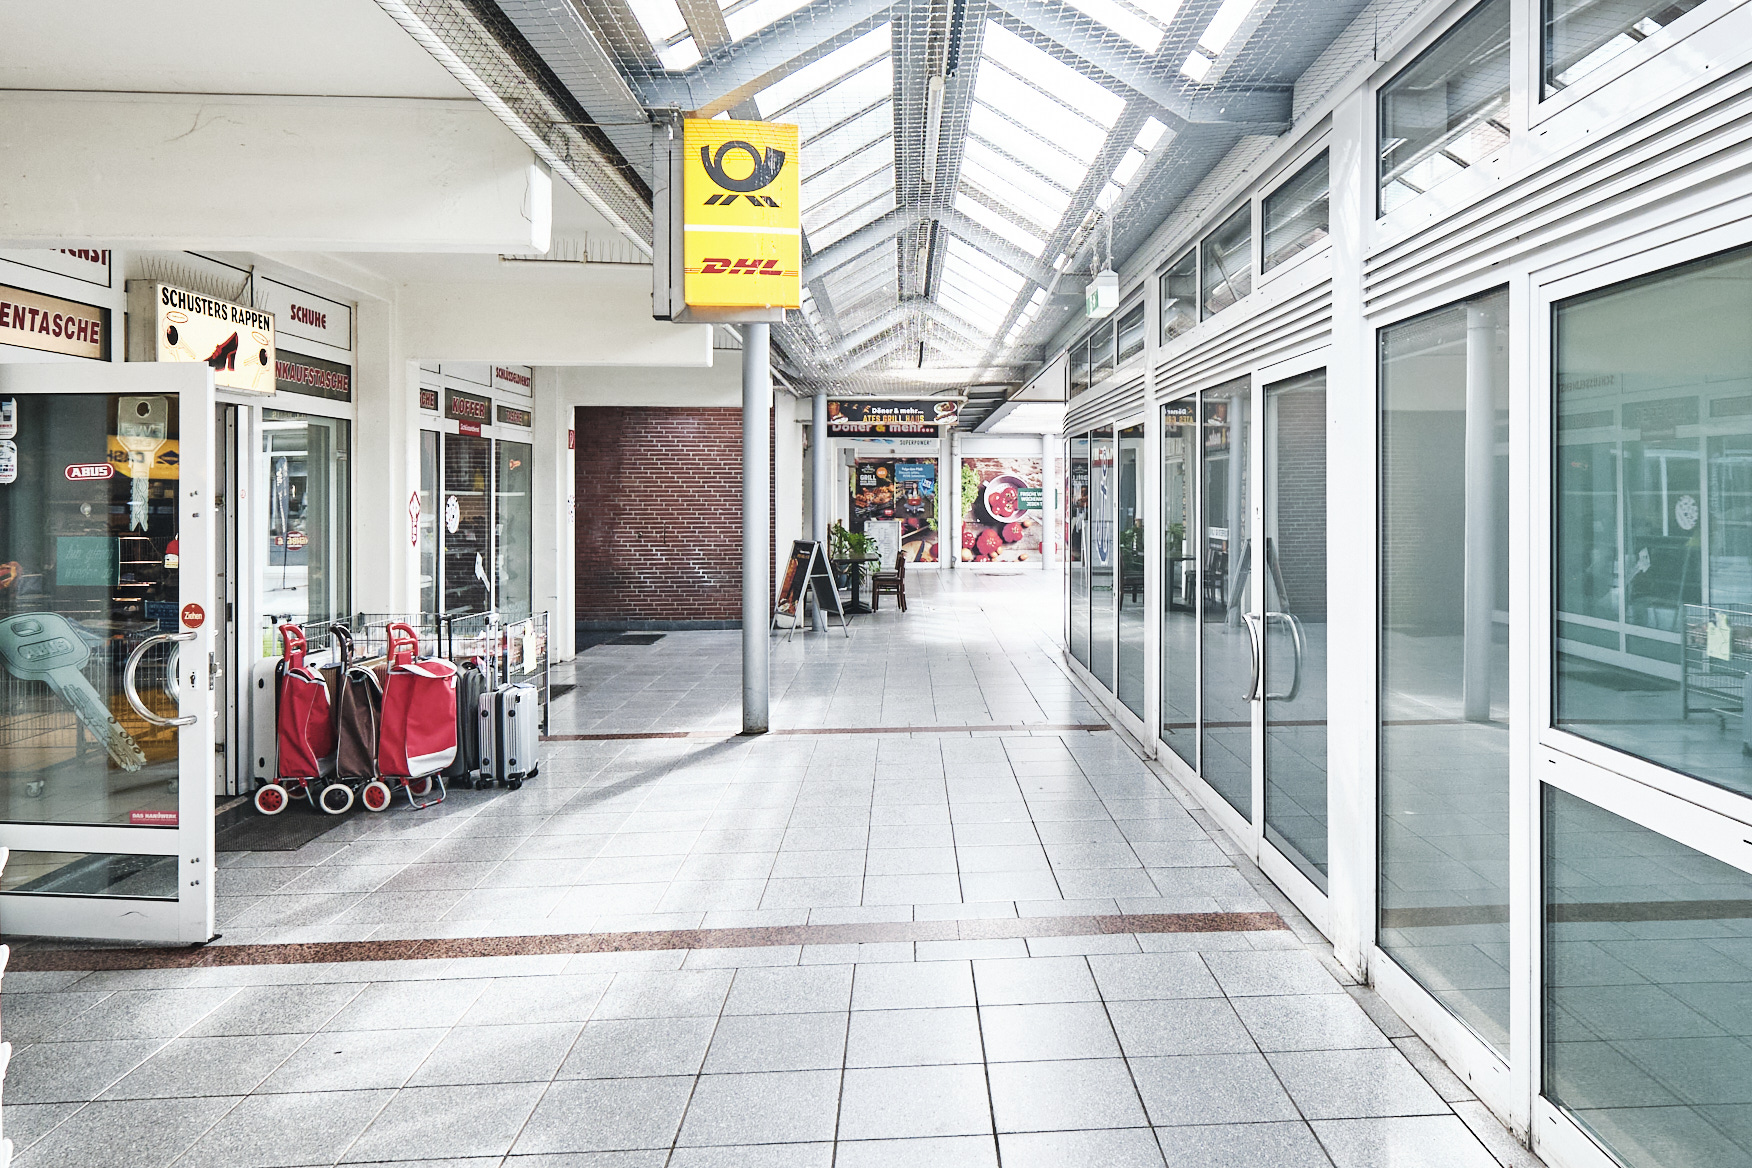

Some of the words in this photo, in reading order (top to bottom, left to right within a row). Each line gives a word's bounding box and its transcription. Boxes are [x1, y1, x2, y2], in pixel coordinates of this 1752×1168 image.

[701, 258, 783, 275] DHL
[161, 286, 229, 320] SCHUSTERS
[231, 306, 271, 332] RAPPEN
[290, 303, 327, 330] SCHUHE
[420, 390, 435, 408] CHE
[452, 396, 485, 419] KOFFER
[862, 414, 881, 422] ATES
[882, 414, 902, 422] GRILL
[906, 414, 925, 422] HAUS
[871, 407, 893, 415] Döner
[70, 465, 108, 478] ABUS
[184, 611, 203, 620] Ziehen
